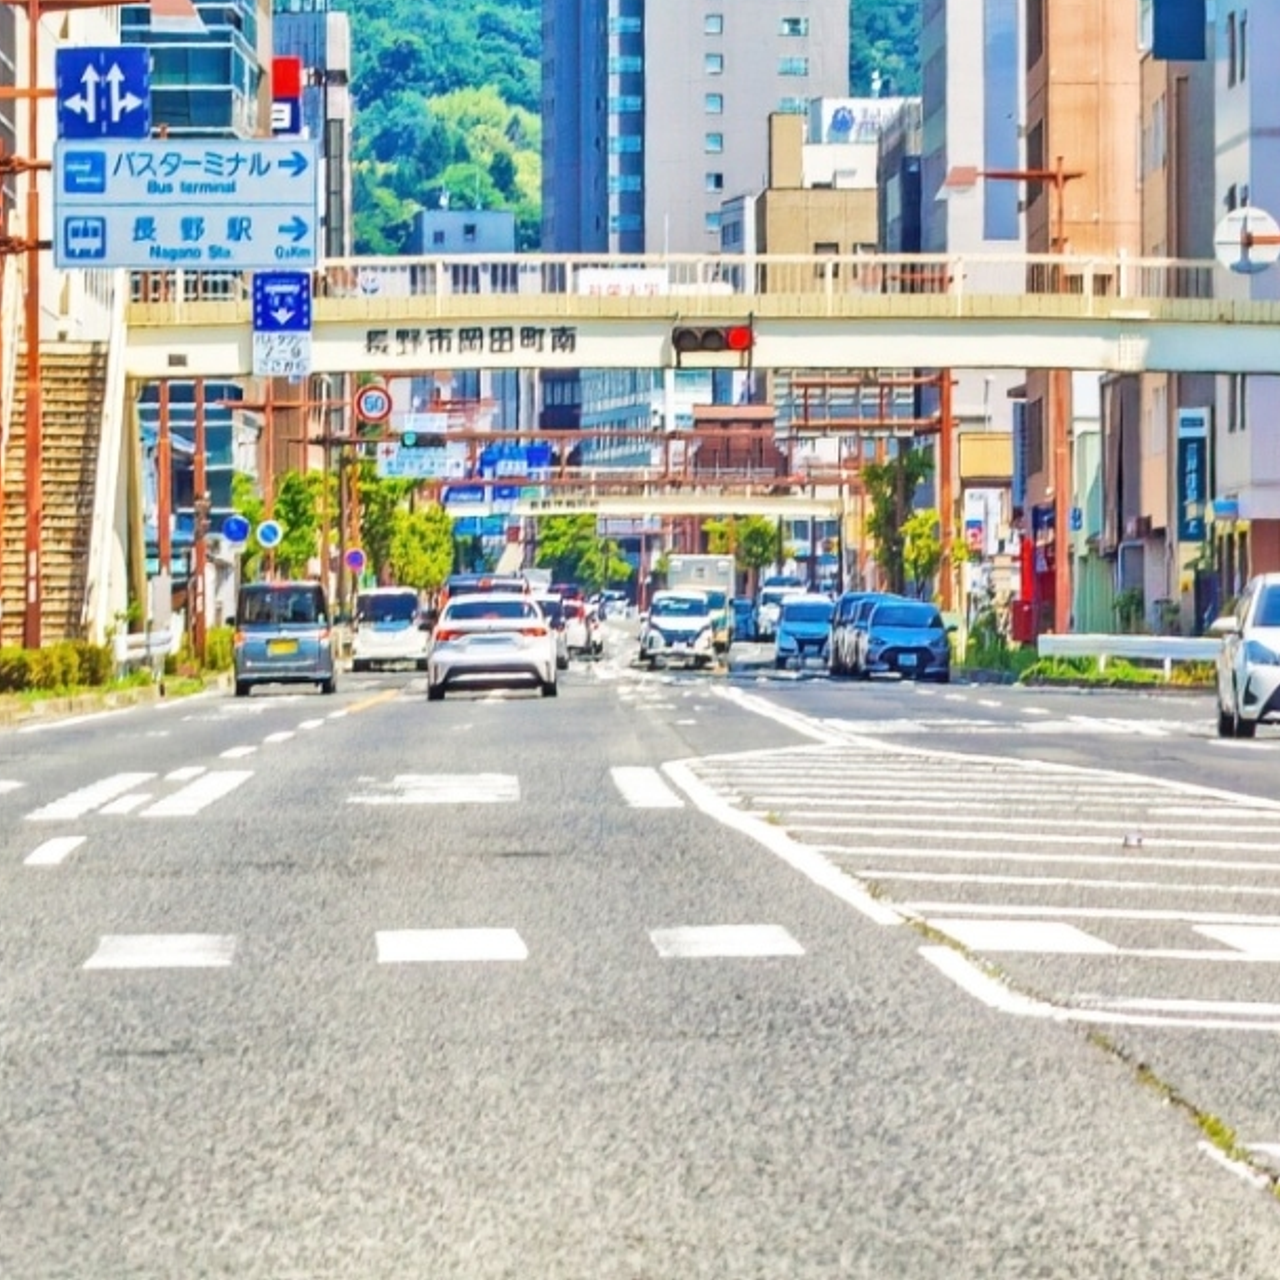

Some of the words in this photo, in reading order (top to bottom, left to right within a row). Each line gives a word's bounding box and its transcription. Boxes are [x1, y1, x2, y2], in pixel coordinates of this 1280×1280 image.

[113, 151, 271, 177] バスターミナル
[147, 180, 174, 195] Bus
[180, 180, 237, 195] terminal
[132, 216, 252, 242] 長野駅
[149, 245, 201, 262] Nagano
[365, 325, 578, 357] 長野市岡田町南
